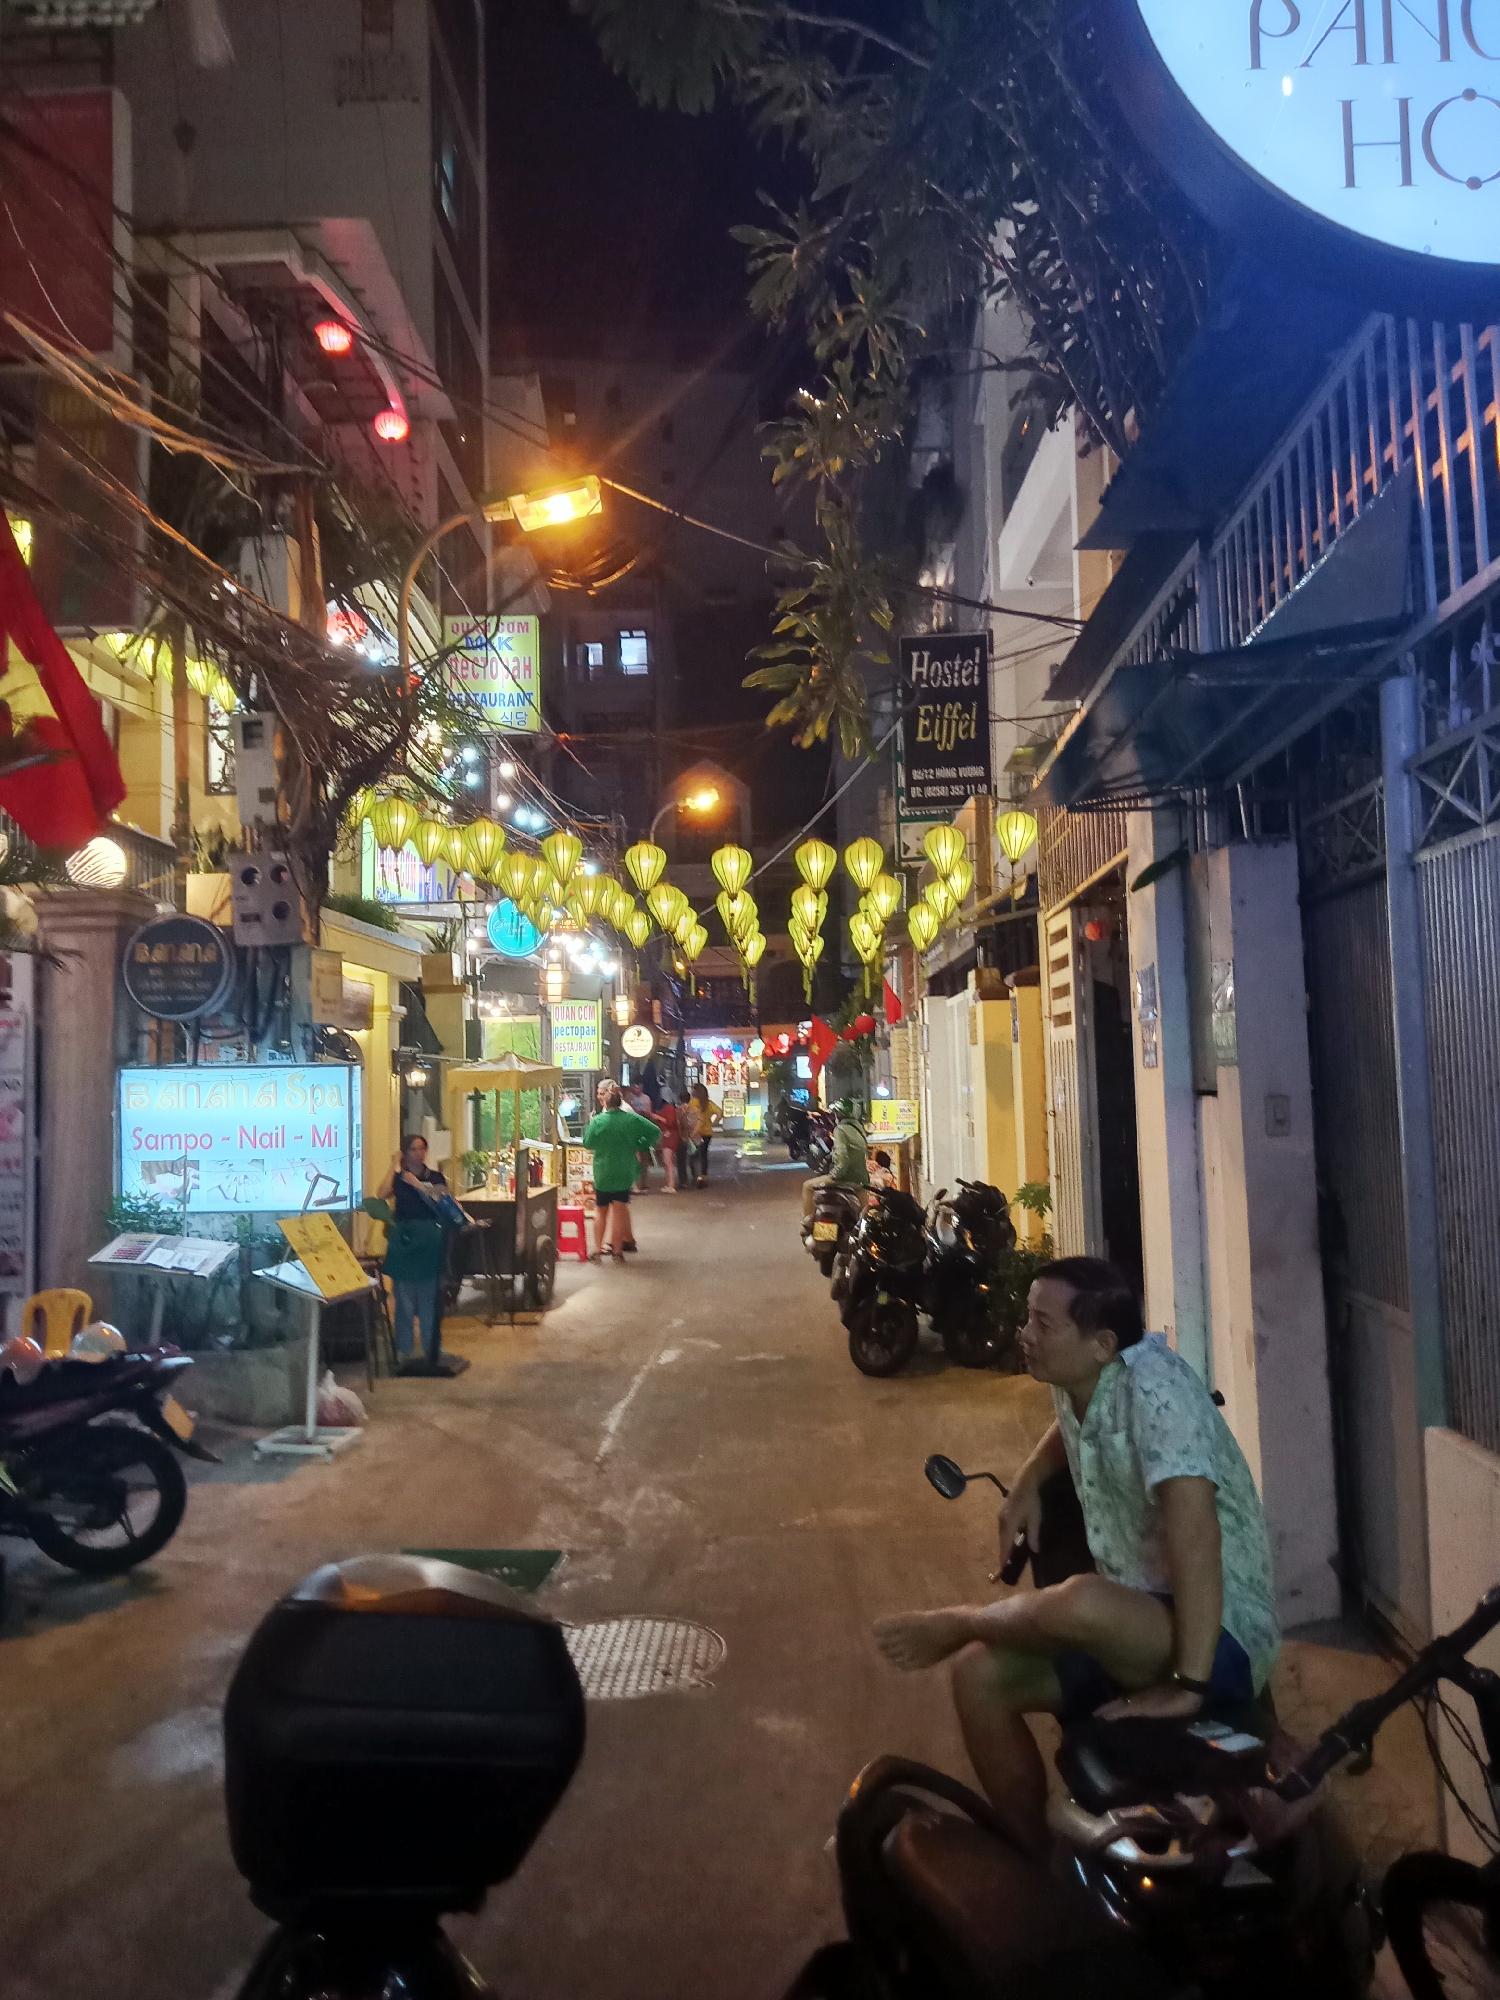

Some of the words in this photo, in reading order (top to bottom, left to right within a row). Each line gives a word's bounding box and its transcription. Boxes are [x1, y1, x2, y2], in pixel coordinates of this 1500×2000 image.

[911, 647, 981, 688] Hostel
[500, 711, 529, 728] 식당
[916, 701, 978, 751] Eiffel
[555, 1003, 576, 1023] QUÁN
[577, 1004, 596, 1021] CƠM
[554, 1026, 596, 1039] ресторан
[554, 1042, 596, 1052] RESTAURANT
[125, 1080, 278, 1110] BANANA
[286, 1072, 344, 1115] Spa
[131, 1127, 213, 1155] Sampo
[238, 1125, 285, 1149] Nail
[311, 1124, 338, 1148] Mi
